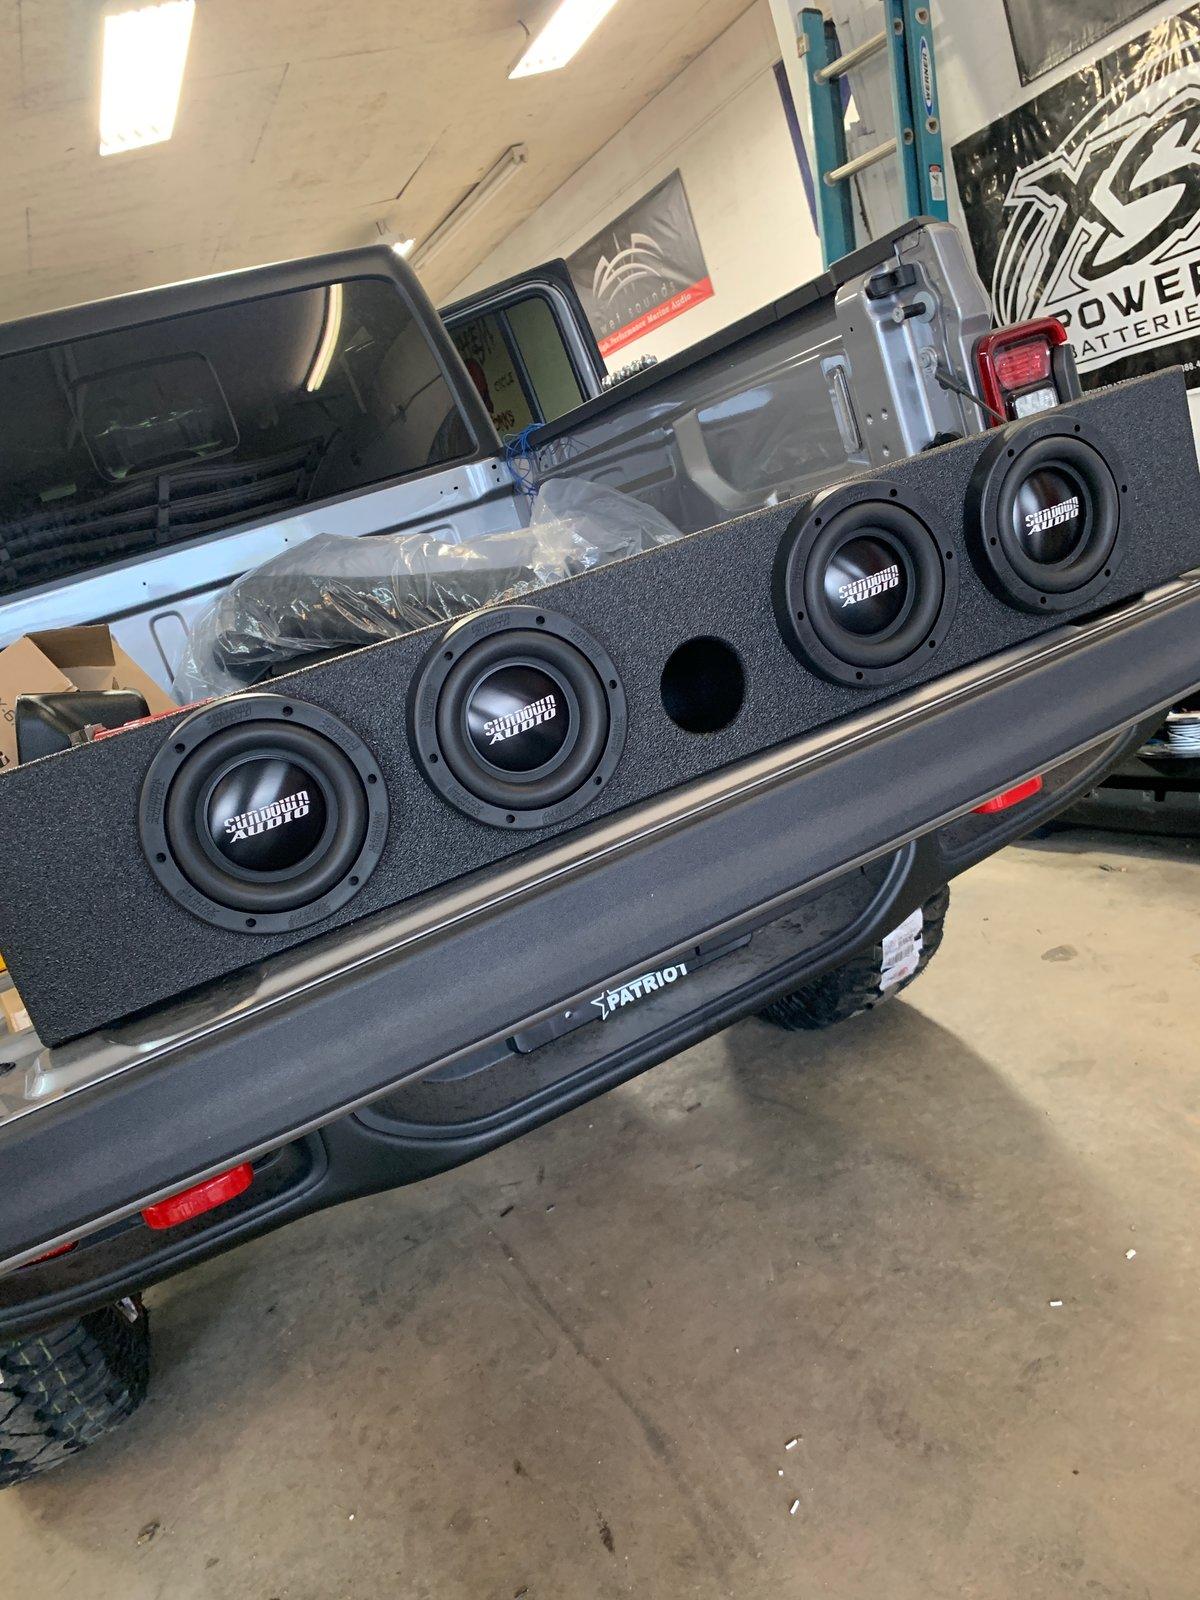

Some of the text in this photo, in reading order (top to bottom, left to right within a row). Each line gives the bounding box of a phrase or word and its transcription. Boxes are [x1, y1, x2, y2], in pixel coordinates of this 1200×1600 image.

[922, 51, 932, 101] WERNER
[600, 280, 676, 334] wet sounds
[671, 292, 692, 310] Audio
[1025, 496, 1079, 527] SUNDOWN
[1027, 508, 1079, 536] AUDIO
[838, 564, 899, 599] SUNDOWN
[842, 577, 899, 608] AUDIO
[483, 694, 556, 736] SUNDOWN
[489, 707, 556, 745] AUDIO
[223, 790, 310, 834] SUNDOWN
[230, 804, 309, 844] AUDIO
[606, 963, 688, 1012] PATRIOT
